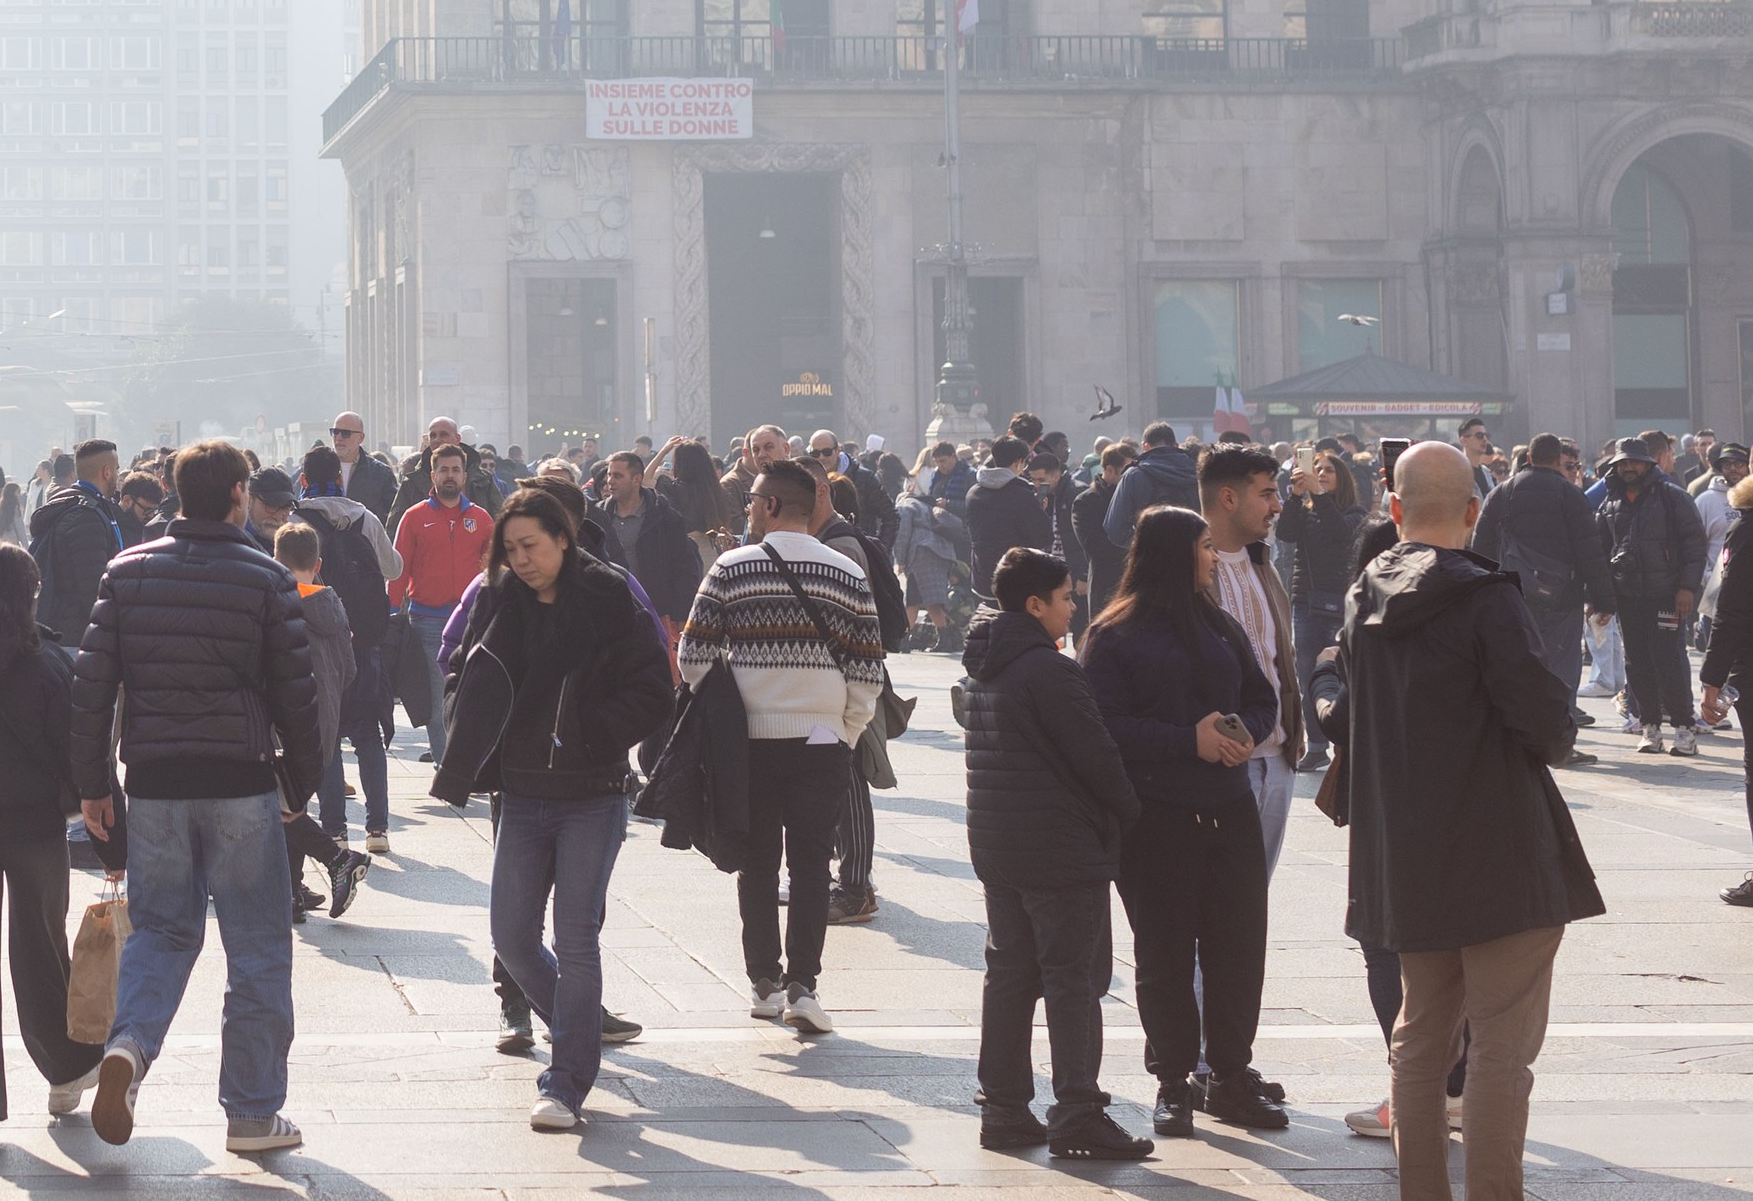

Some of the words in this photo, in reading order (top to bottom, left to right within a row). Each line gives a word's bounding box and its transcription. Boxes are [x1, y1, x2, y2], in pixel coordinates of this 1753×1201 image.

[589, 83, 666, 98] INSIEME
[670, 83, 751, 98] CONTRO
[608, 102, 632, 117] LA
[635, 102, 734, 117] VIOLENZA
[602, 120, 664, 135] SULLE
[669, 120, 739, 135] DONNE
[1331, 403, 1377, 412] SOUVENIR
[1384, 403, 1421, 412] GADGET
[1429, 403, 1467, 411] EDICOLA
